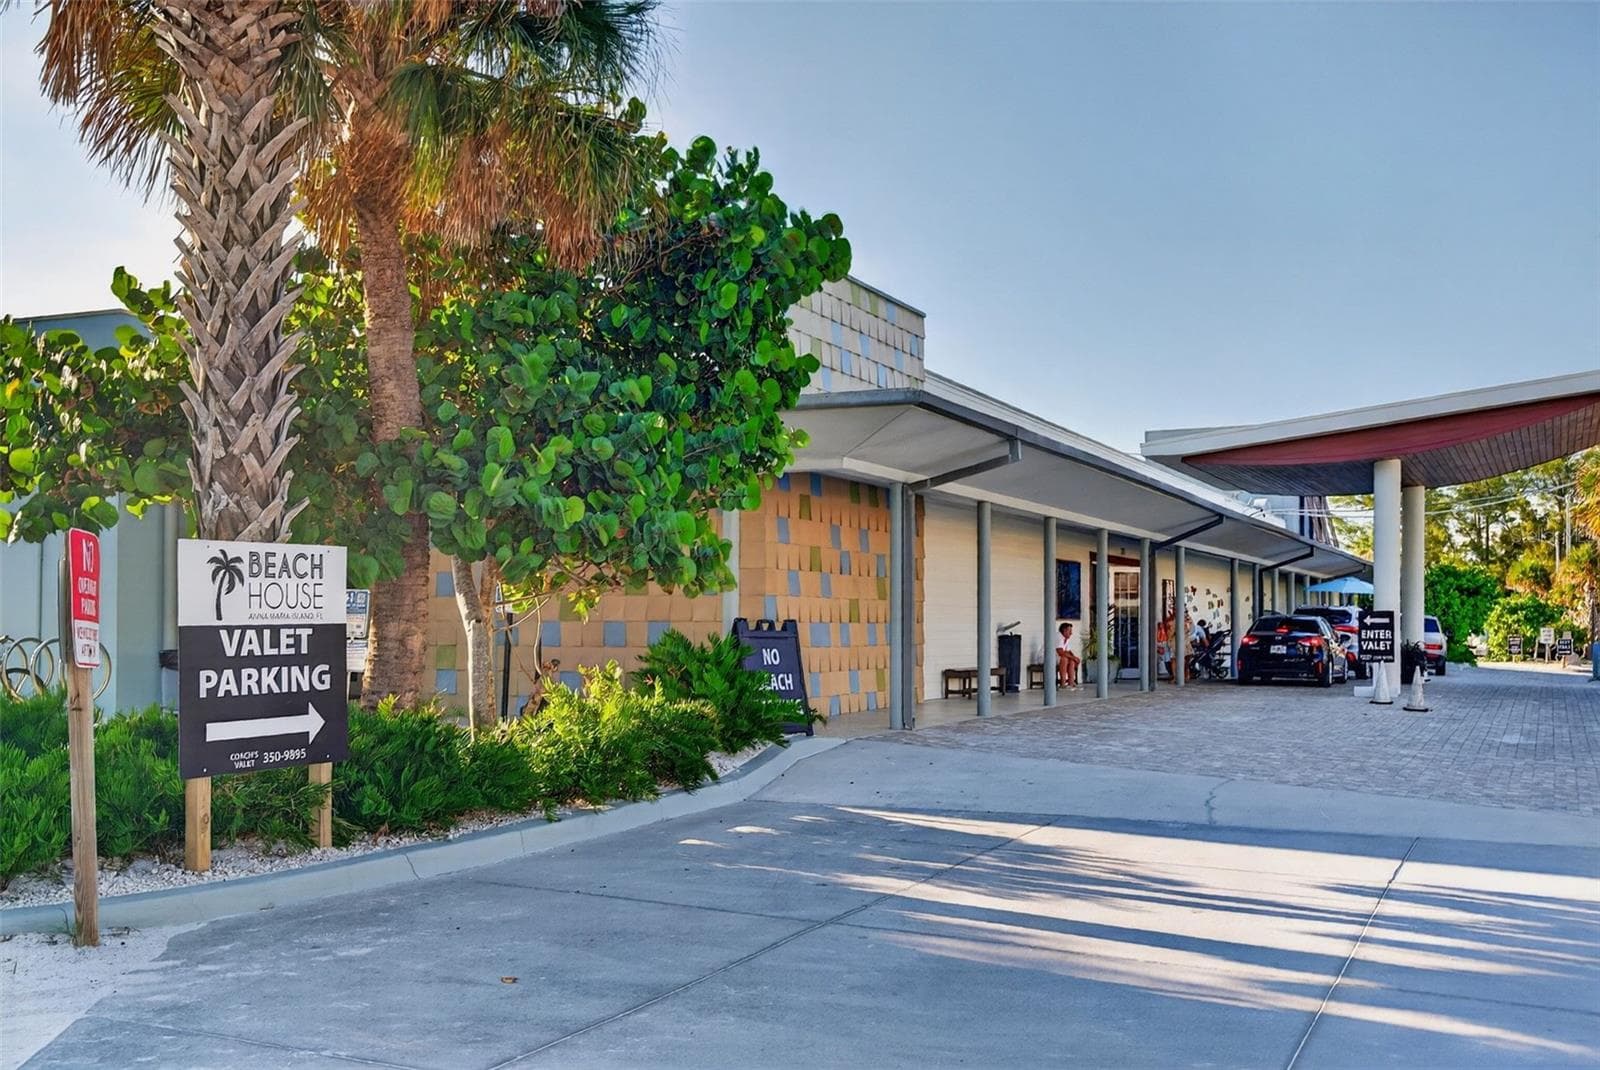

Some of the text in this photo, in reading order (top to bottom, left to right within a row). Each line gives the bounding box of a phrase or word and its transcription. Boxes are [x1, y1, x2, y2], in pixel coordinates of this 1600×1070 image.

[248, 551, 324, 579] BEACH
[248, 582, 324, 610] HOUSE
[219, 628, 313, 657] VALET
[1361, 629, 1392, 639] ENTER
[1361, 641, 1392, 650] VALET
[762, 648, 780, 666] NO
[199, 664, 331, 698] PARKING
[234, 760, 255, 769] VALET
[262, 749, 306, 763] 350-9895
